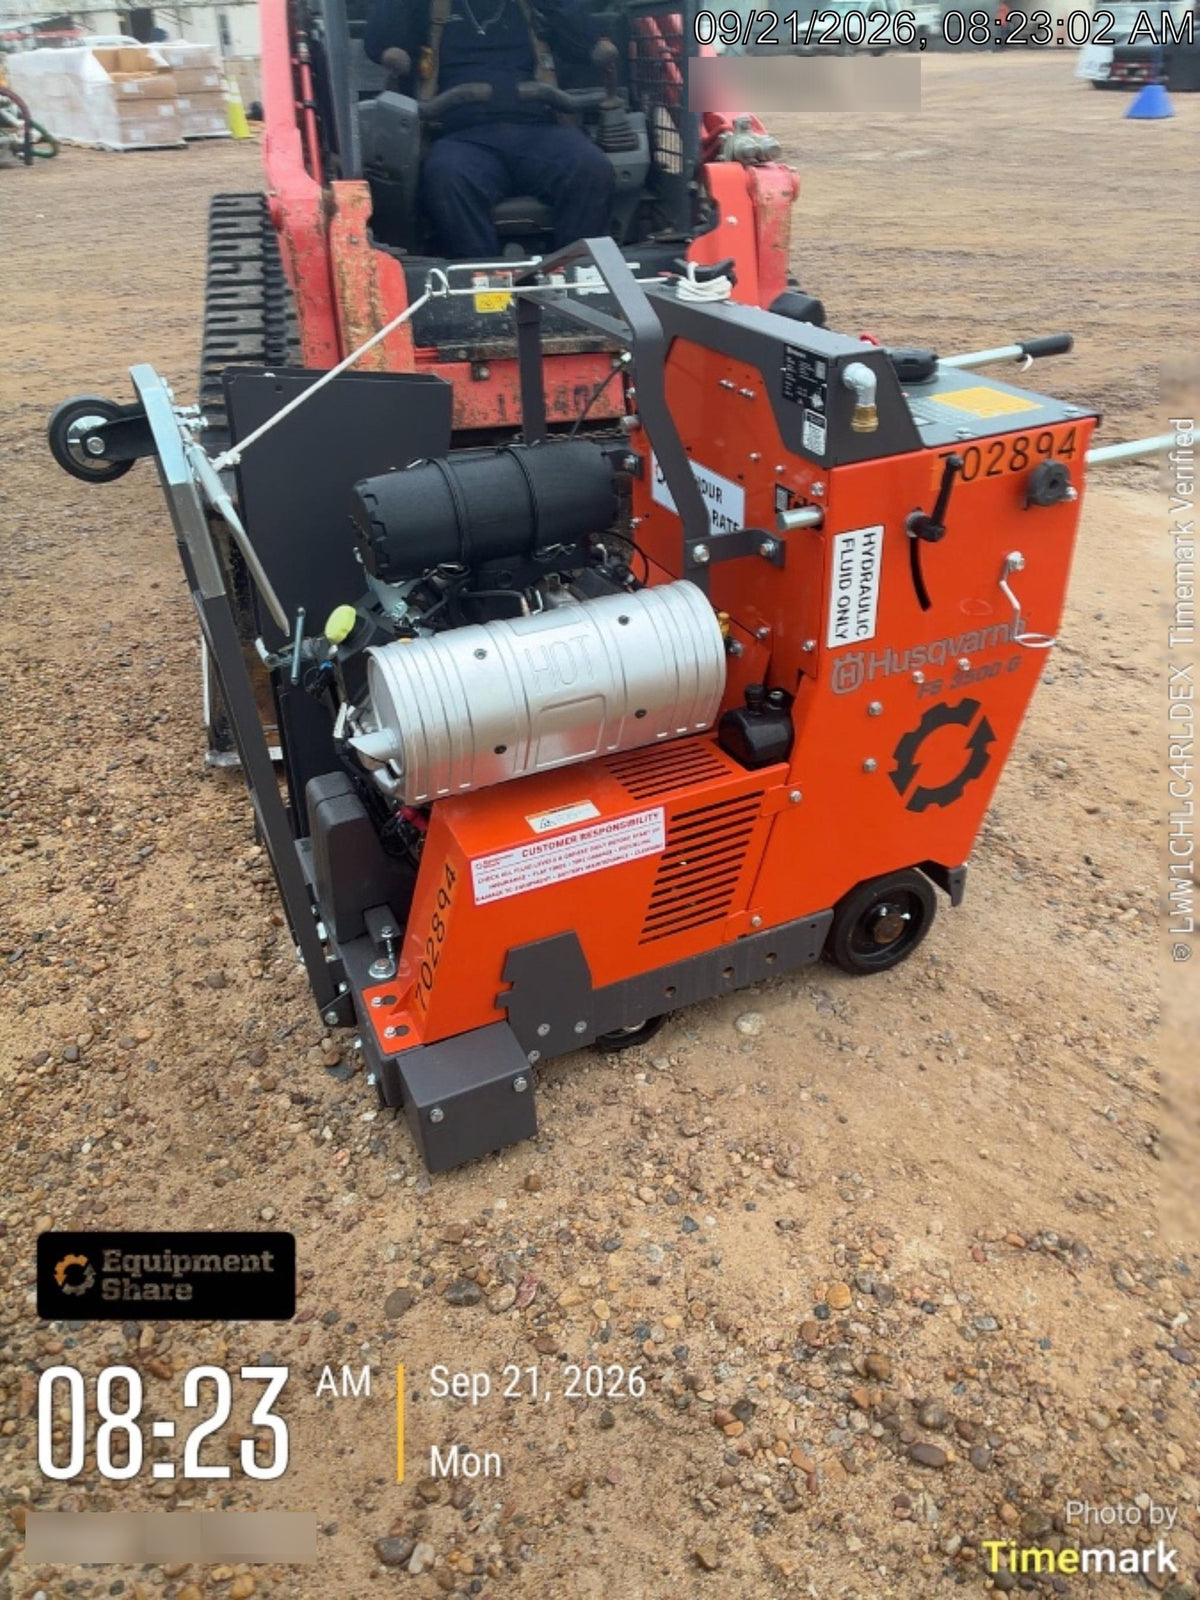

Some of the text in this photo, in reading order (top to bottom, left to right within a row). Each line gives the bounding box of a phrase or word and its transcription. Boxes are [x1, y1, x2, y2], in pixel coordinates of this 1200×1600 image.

[835, 538, 855, 639] FLUID ONLY
[856, 533, 876, 637] HYDRAULIC
[525, 634, 596, 697] HOT
[522, 834, 577, 858] CUSTOMER
[580, 812, 660, 841] RESPONSIBILITY
[415, 863, 456, 1011] 702894
